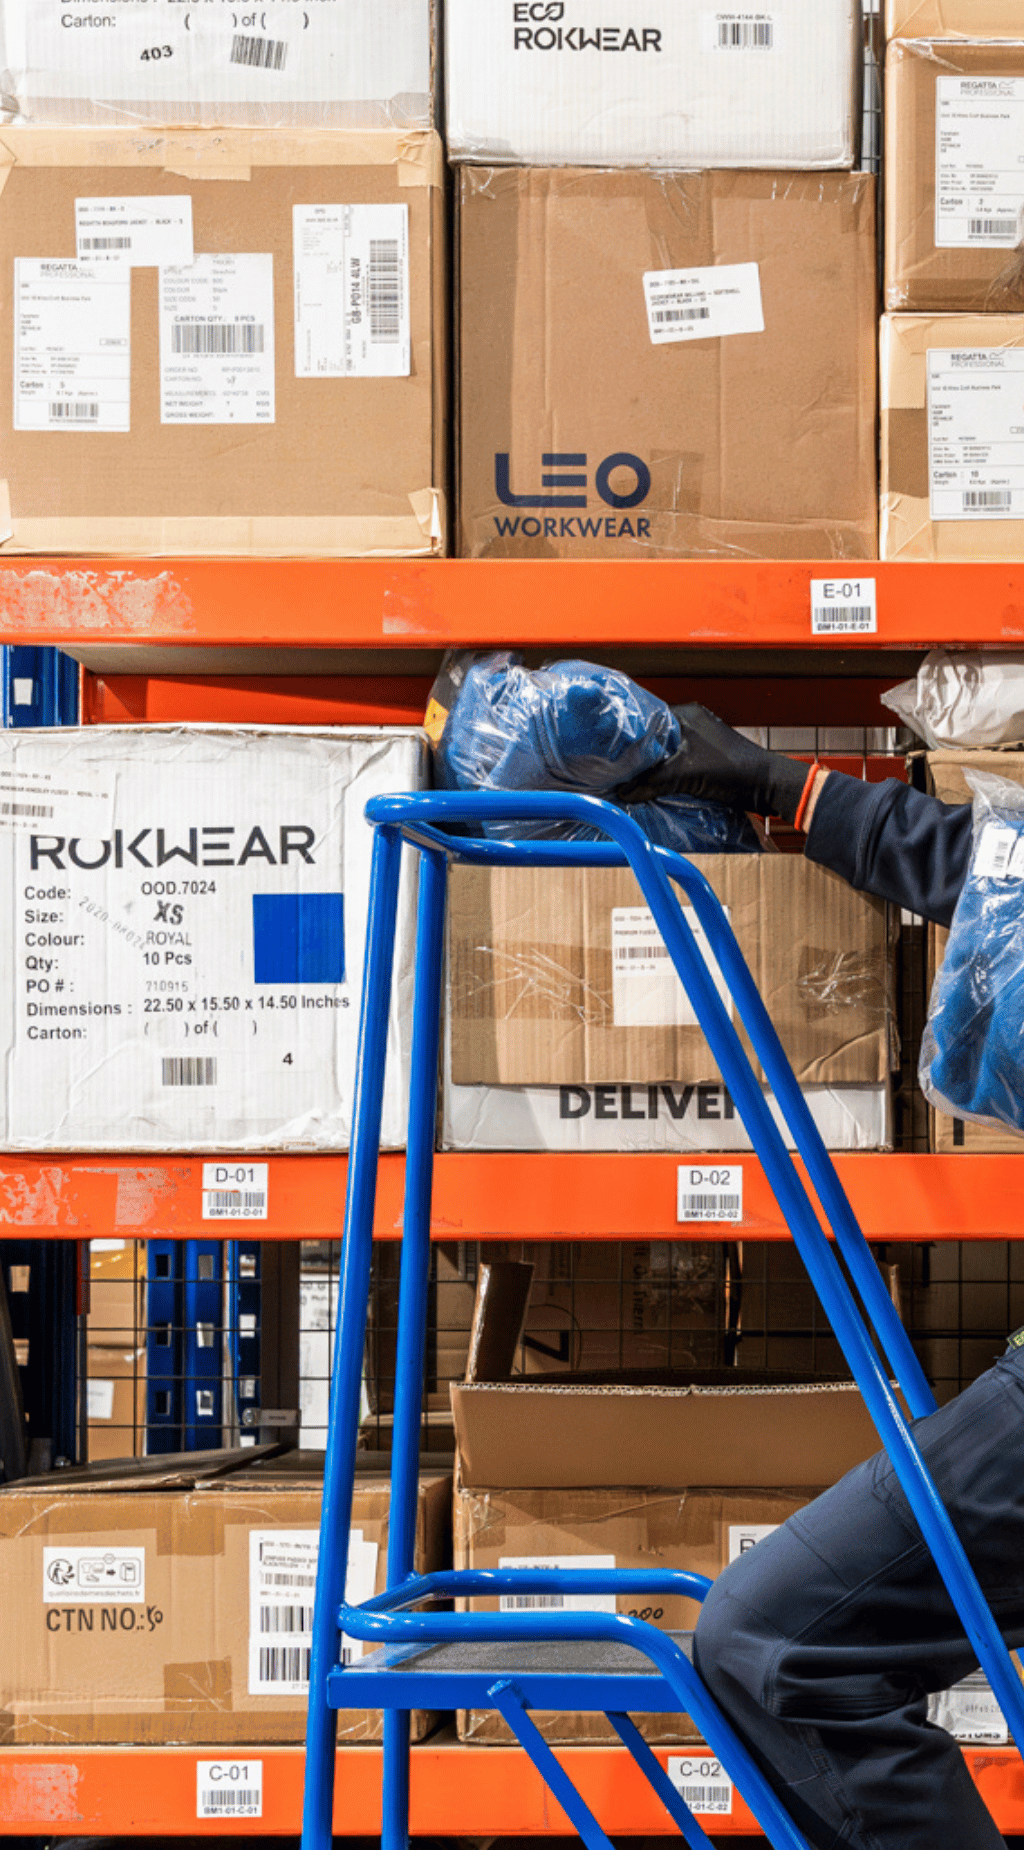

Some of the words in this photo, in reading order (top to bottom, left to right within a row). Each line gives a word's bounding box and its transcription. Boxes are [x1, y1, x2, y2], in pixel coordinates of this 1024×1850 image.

[61, 14, 116, 28] Carton:
[242, 12, 256, 27] of
[514, 28, 662, 52] ROKWEAR
[140, 45, 173, 61] 403
[494, 452, 651, 508] LEO
[494, 517, 651, 538] WORKWEAR
[823, 583, 860, 598] E-01
[24, 886, 72, 900] Code:
[141, 881, 216, 895] OOD.7024
[24, 909, 65, 923] Size:
[154, 901, 184, 925] XS
[25, 932, 85, 946] Colour:
[147, 931, 192, 946] ROYAL
[25, 957, 59, 971] Qty:
[142, 953, 160, 965] 10
[165, 952, 192, 965] Pcs
[26, 980, 50, 992] PO
[146, 981, 188, 992] 710915
[27, 1002, 122, 1016] Dimensions
[144, 998, 183, 1013] 22.50
[187, 1001, 196, 1012] x
[201, 997, 240, 1012] 15.50
[244, 1000, 253, 1010] x
[258, 996, 297, 1010] 14.50
[301, 996, 350, 1009] Inches
[27, 1026, 87, 1040] Carton:
[194, 1021, 209, 1034] of
[282, 1053, 293, 1065] 4
[216, 1167, 253, 1182] D-01
[690, 1170, 730, 1185] D-02
[46, 1607, 94, 1632] CTN
[210, 1766, 249, 1780] C-01
[680, 1762, 720, 1777] C-02
